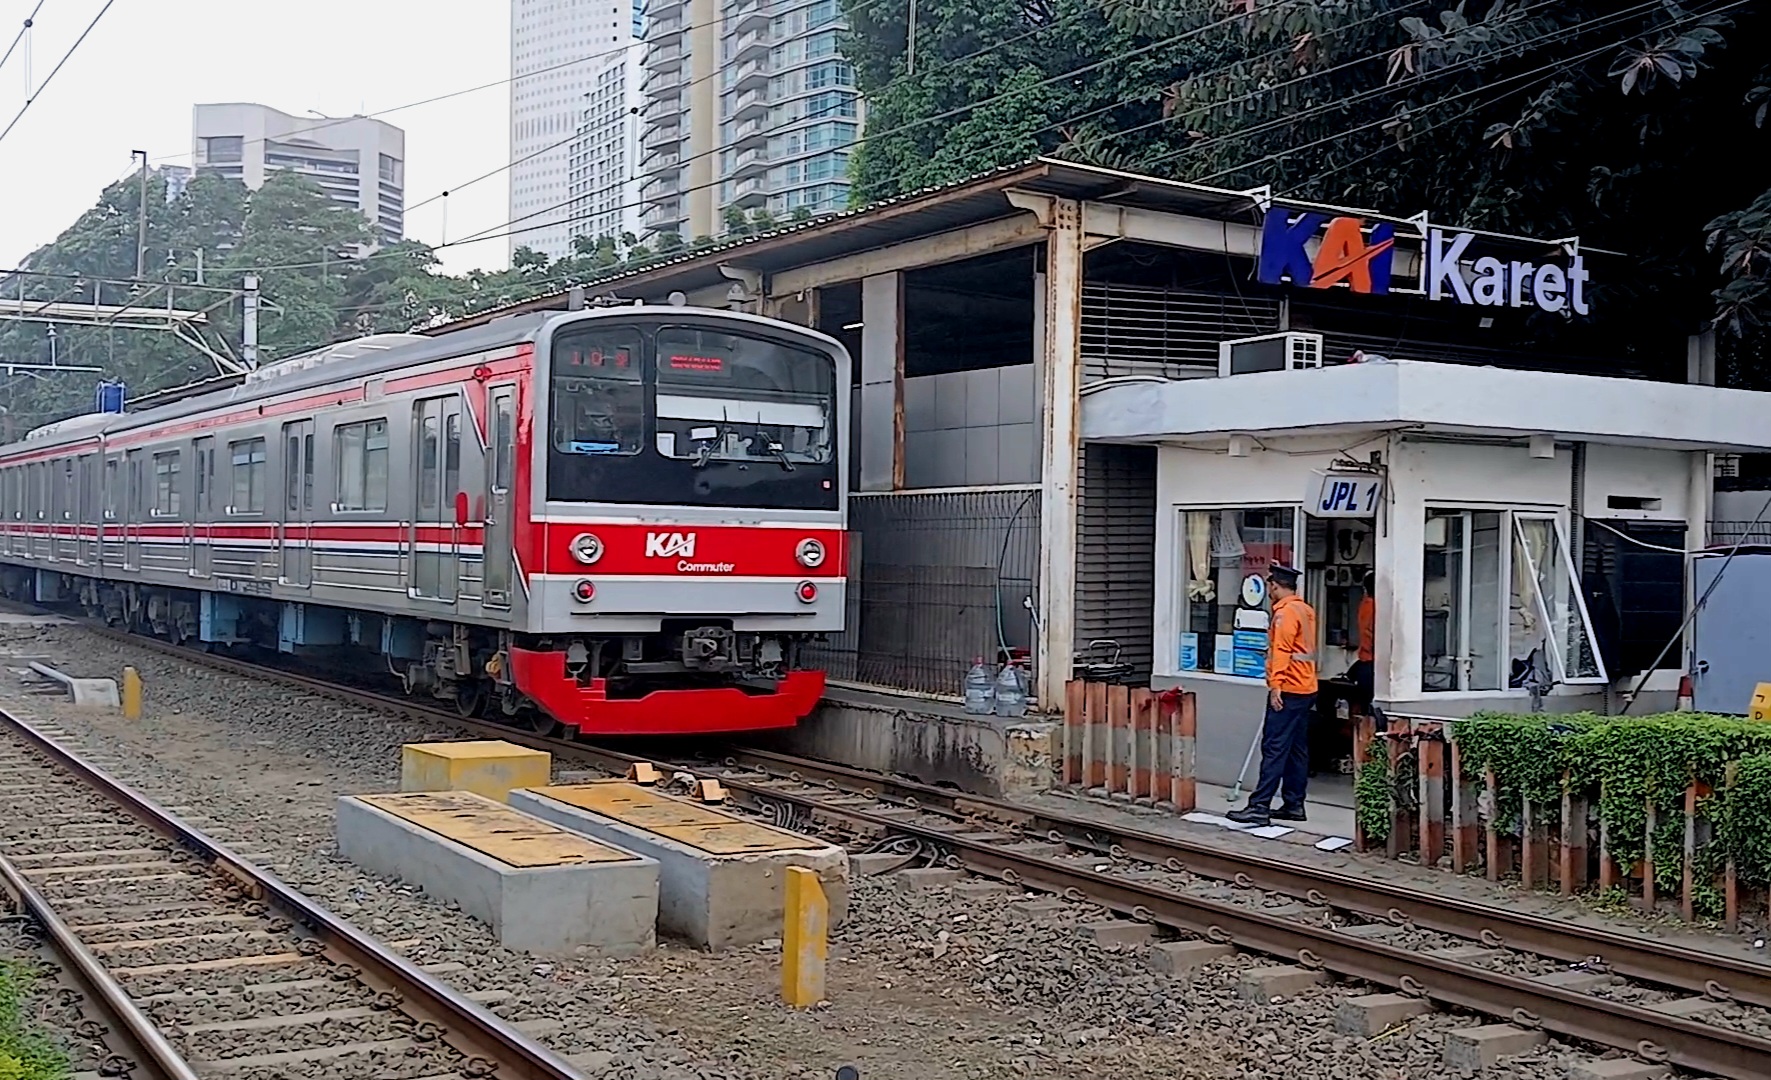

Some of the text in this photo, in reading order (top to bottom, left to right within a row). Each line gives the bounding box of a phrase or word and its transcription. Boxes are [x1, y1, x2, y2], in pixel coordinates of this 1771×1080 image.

[1257, 207, 1590, 316] KAI Karet
[1322, 481, 1378, 511] JPL 1
[645, 532, 696, 557] KAI
[677, 560, 735, 573] Commuter
